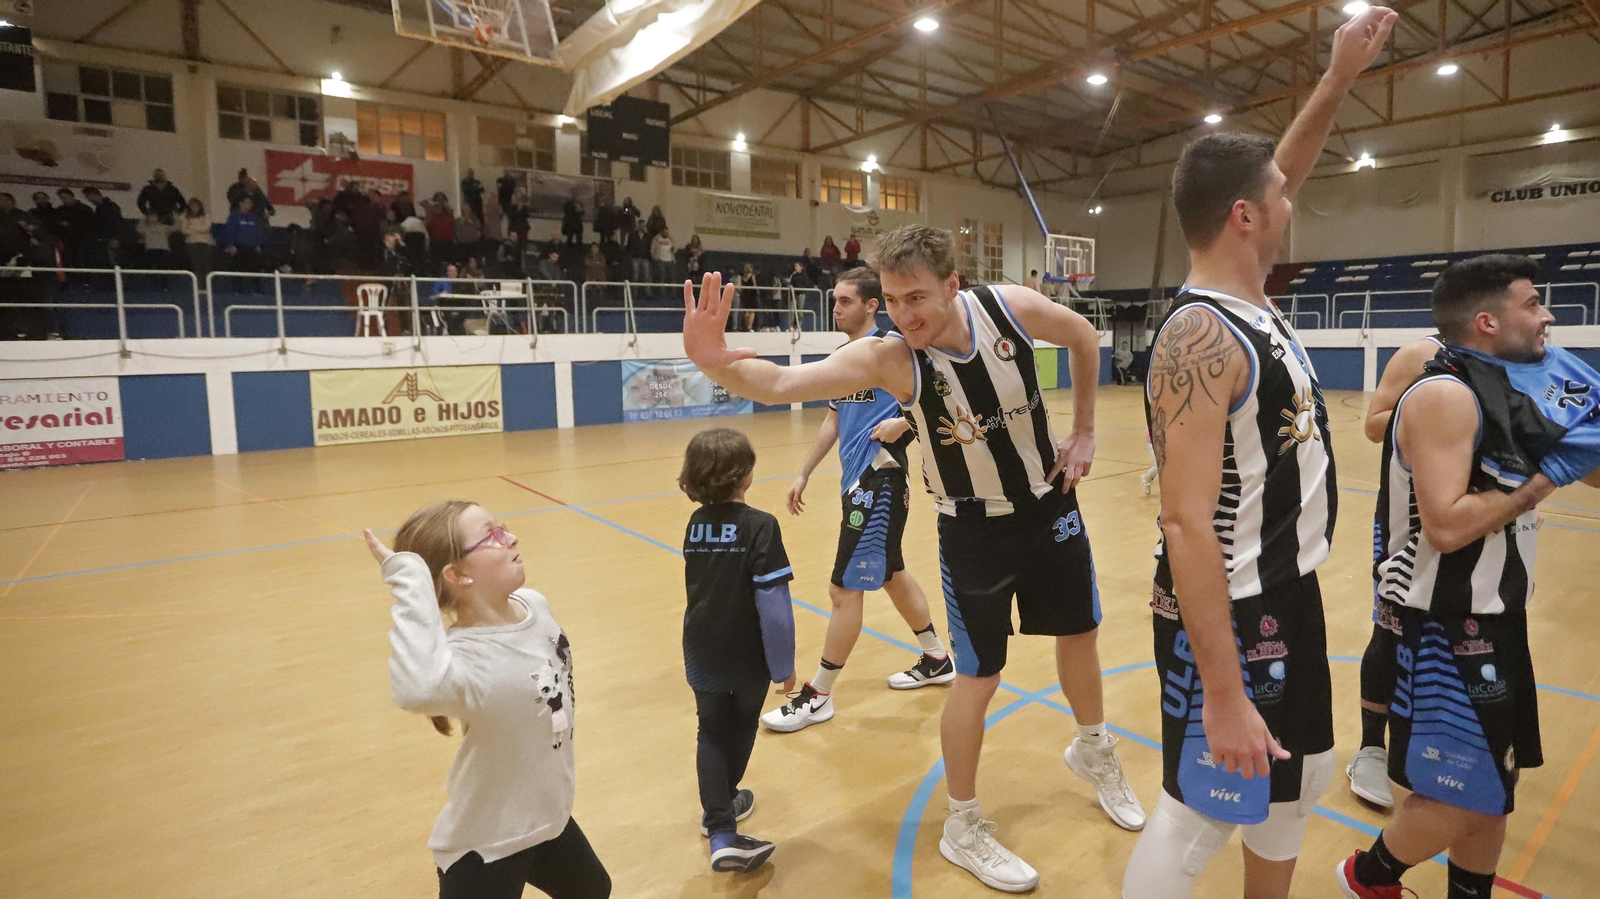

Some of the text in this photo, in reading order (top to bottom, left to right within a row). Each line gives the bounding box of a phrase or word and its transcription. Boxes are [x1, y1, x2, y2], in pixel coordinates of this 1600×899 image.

[1490, 180, 1600, 203] CLUB UNIO
[0, 391, 109, 405] RAMIENTO
[1544, 384, 1559, 401] vive
[0, 406, 114, 430] esarial
[317, 400, 500, 429] AMADO e HIJOS
[57, 438, 117, 449] CONTABLE
[851, 487, 874, 509] 34
[689, 523, 738, 543] ULB
[1052, 510, 1081, 542] 33
[1162, 629, 1195, 718] ULB
[1390, 643, 1414, 718] ULB
[1437, 775, 1465, 791] vive
[1210, 788, 1241, 803] vive
